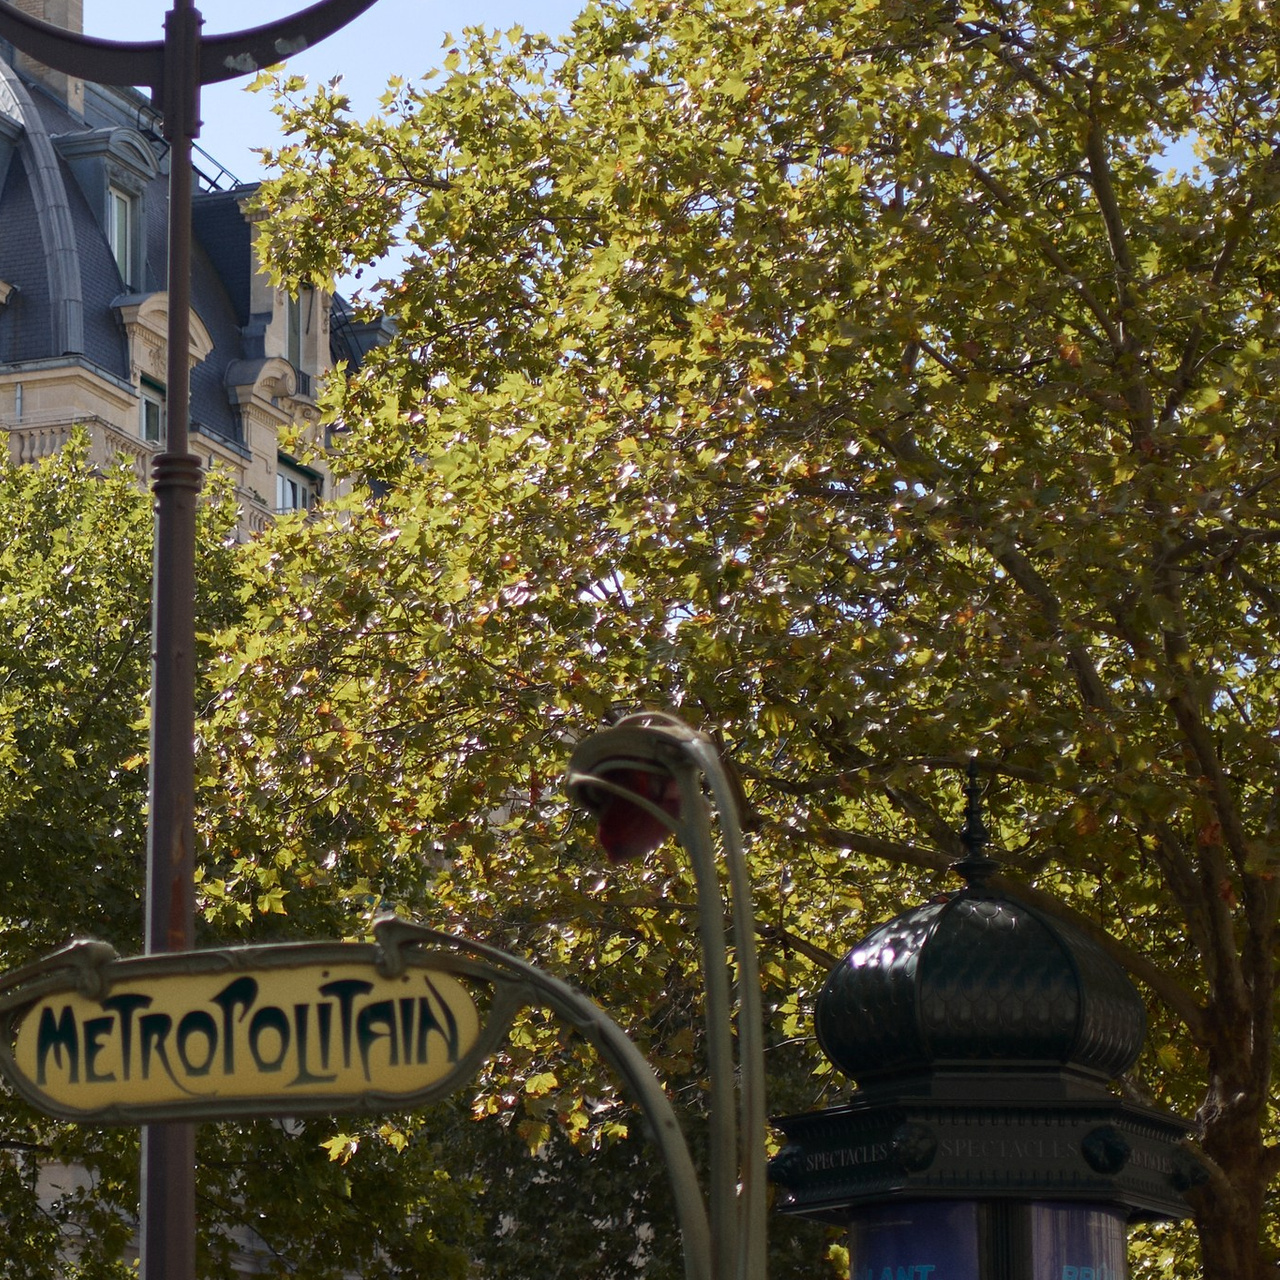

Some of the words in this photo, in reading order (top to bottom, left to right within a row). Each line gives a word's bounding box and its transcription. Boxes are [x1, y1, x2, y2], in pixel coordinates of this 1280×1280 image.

[36, 971, 459, 1096] METROPOLITAIN
[805, 1143, 888, 1172] SPECTACLES
[941, 1139, 1080, 1160] SPECTACLES
